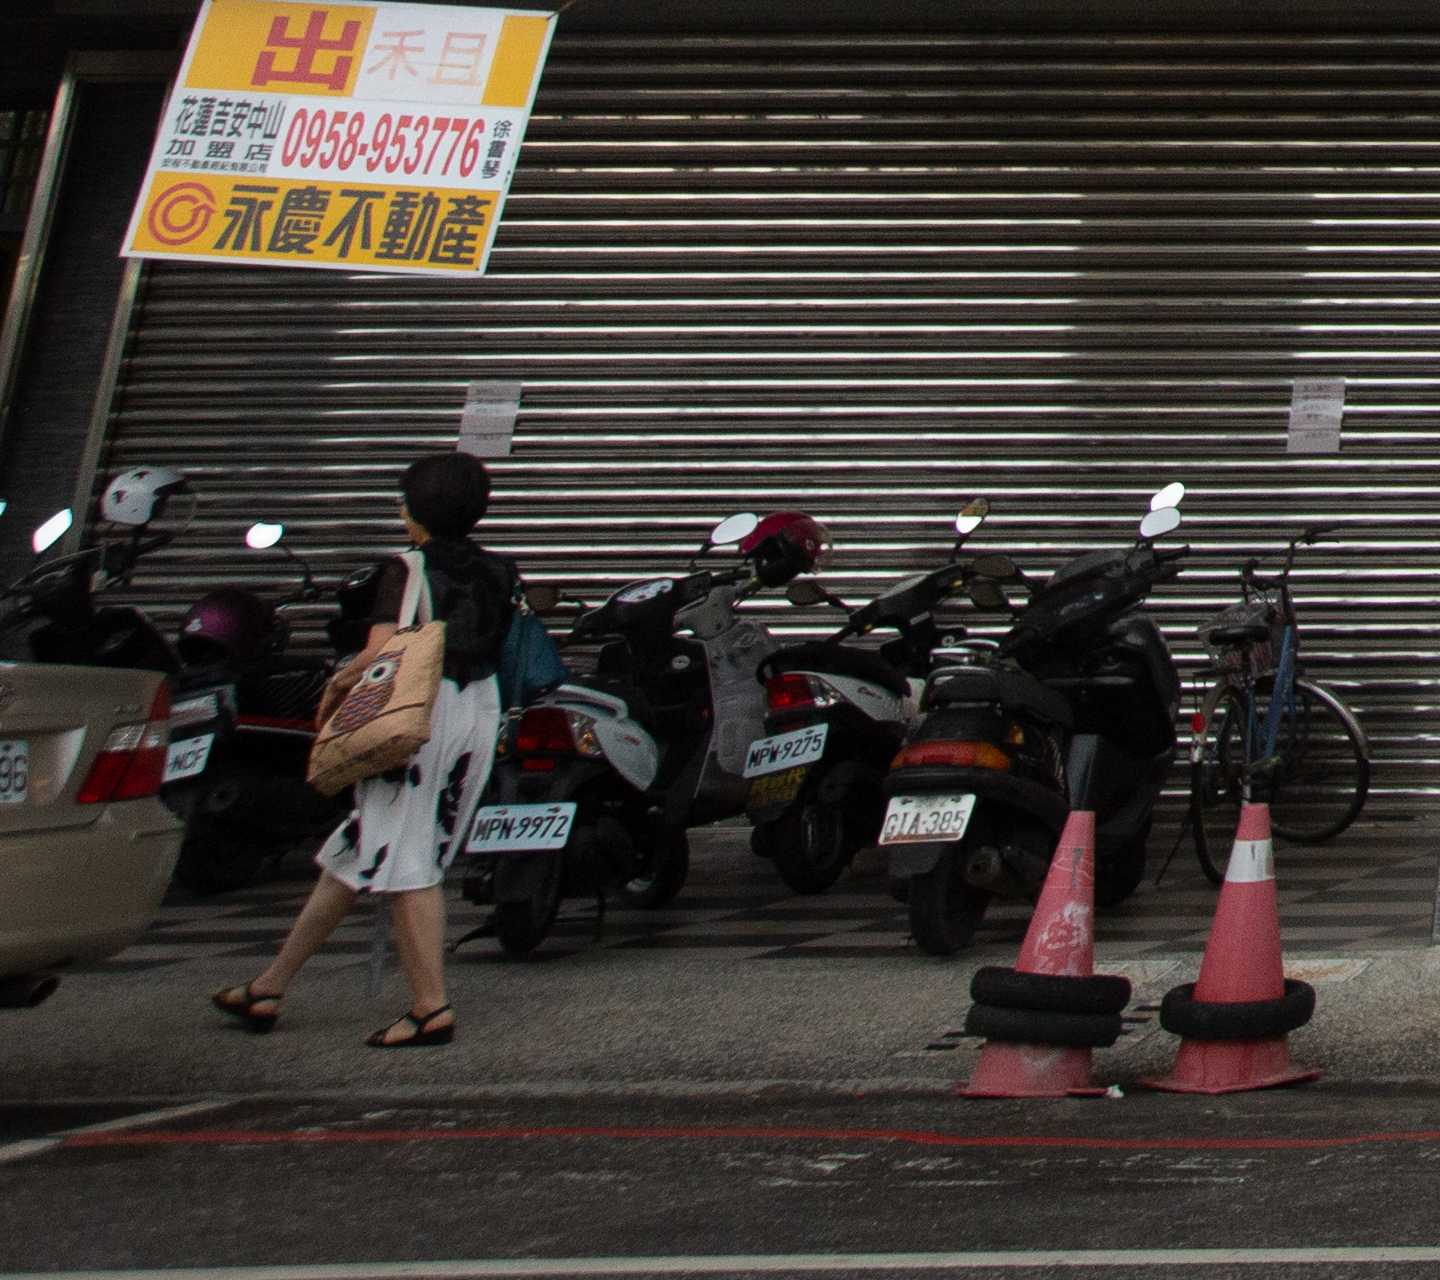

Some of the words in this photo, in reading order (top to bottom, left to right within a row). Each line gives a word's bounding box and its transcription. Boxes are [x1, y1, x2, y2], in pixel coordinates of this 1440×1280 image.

[166, 139, 274, 161] 加盟店
[282, 108, 485, 177] 0958-953776
[213, 184, 491, 265] 永慶不動產
[473, 813, 569, 841] MPN-9972
